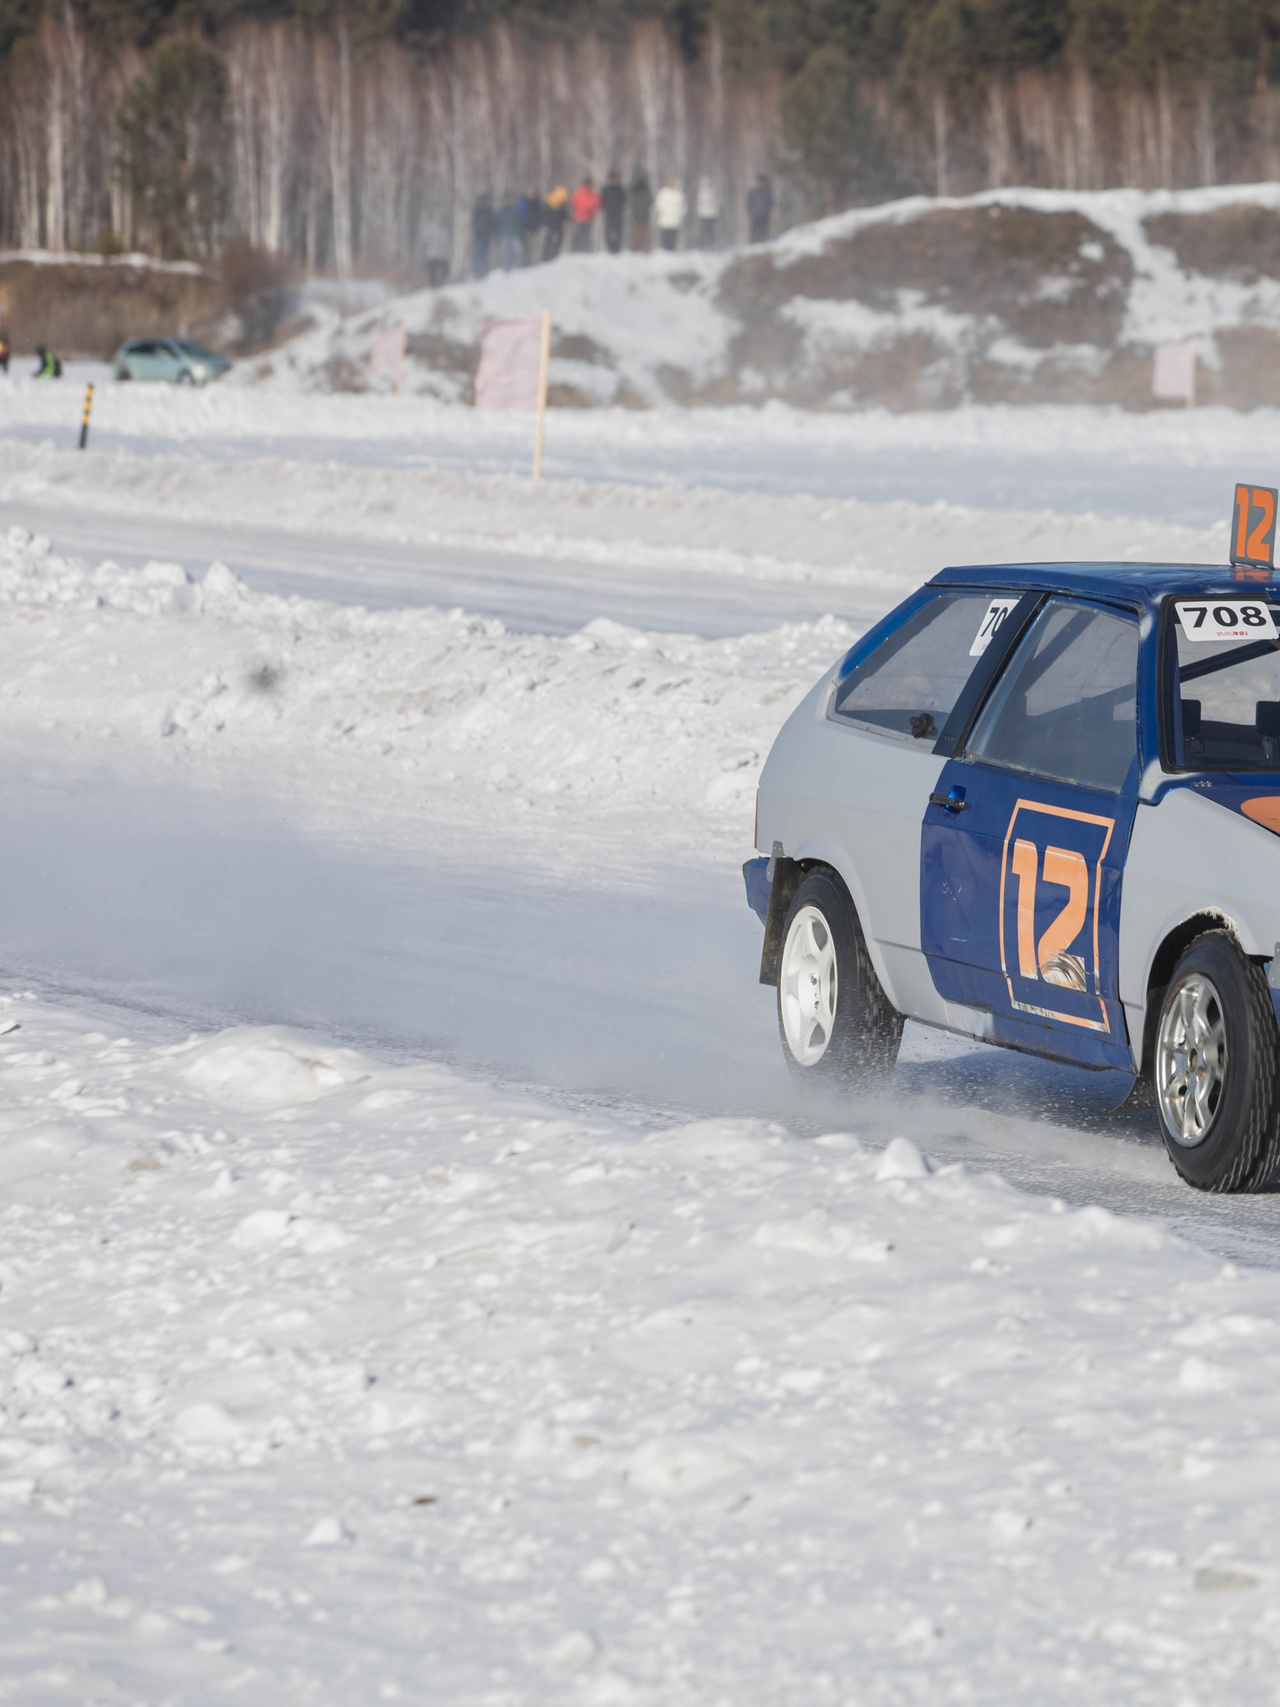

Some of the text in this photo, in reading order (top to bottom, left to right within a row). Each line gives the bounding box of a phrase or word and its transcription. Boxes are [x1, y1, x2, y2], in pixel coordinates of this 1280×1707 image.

[1236, 486, 1275, 562] 12
[1182, 606, 1267, 628] 708
[1012, 838, 1088, 992] 12
